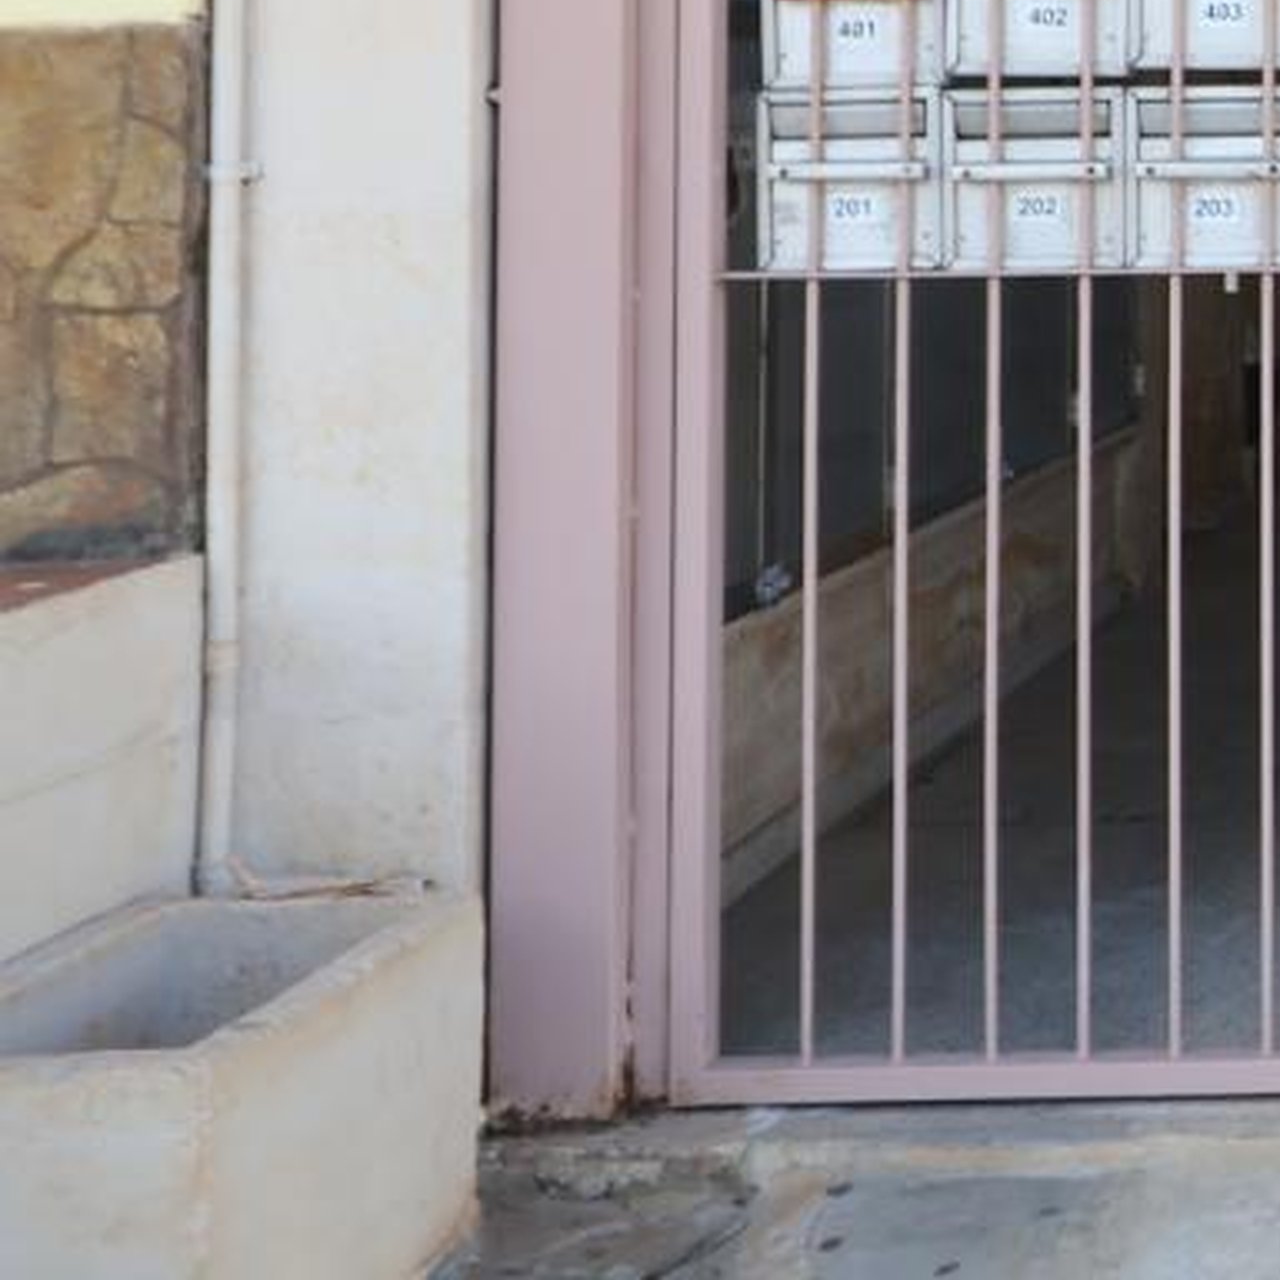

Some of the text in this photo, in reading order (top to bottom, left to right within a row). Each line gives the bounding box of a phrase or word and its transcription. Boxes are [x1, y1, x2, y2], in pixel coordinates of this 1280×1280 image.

[1029, 8, 1067, 27] 402
[1203, 2, 1243, 21] 403
[837, 20, 876, 38] 401
[834, 198, 872, 217] 201
[1017, 197, 1056, 216] 202
[1194, 198, 1233, 217] 203
